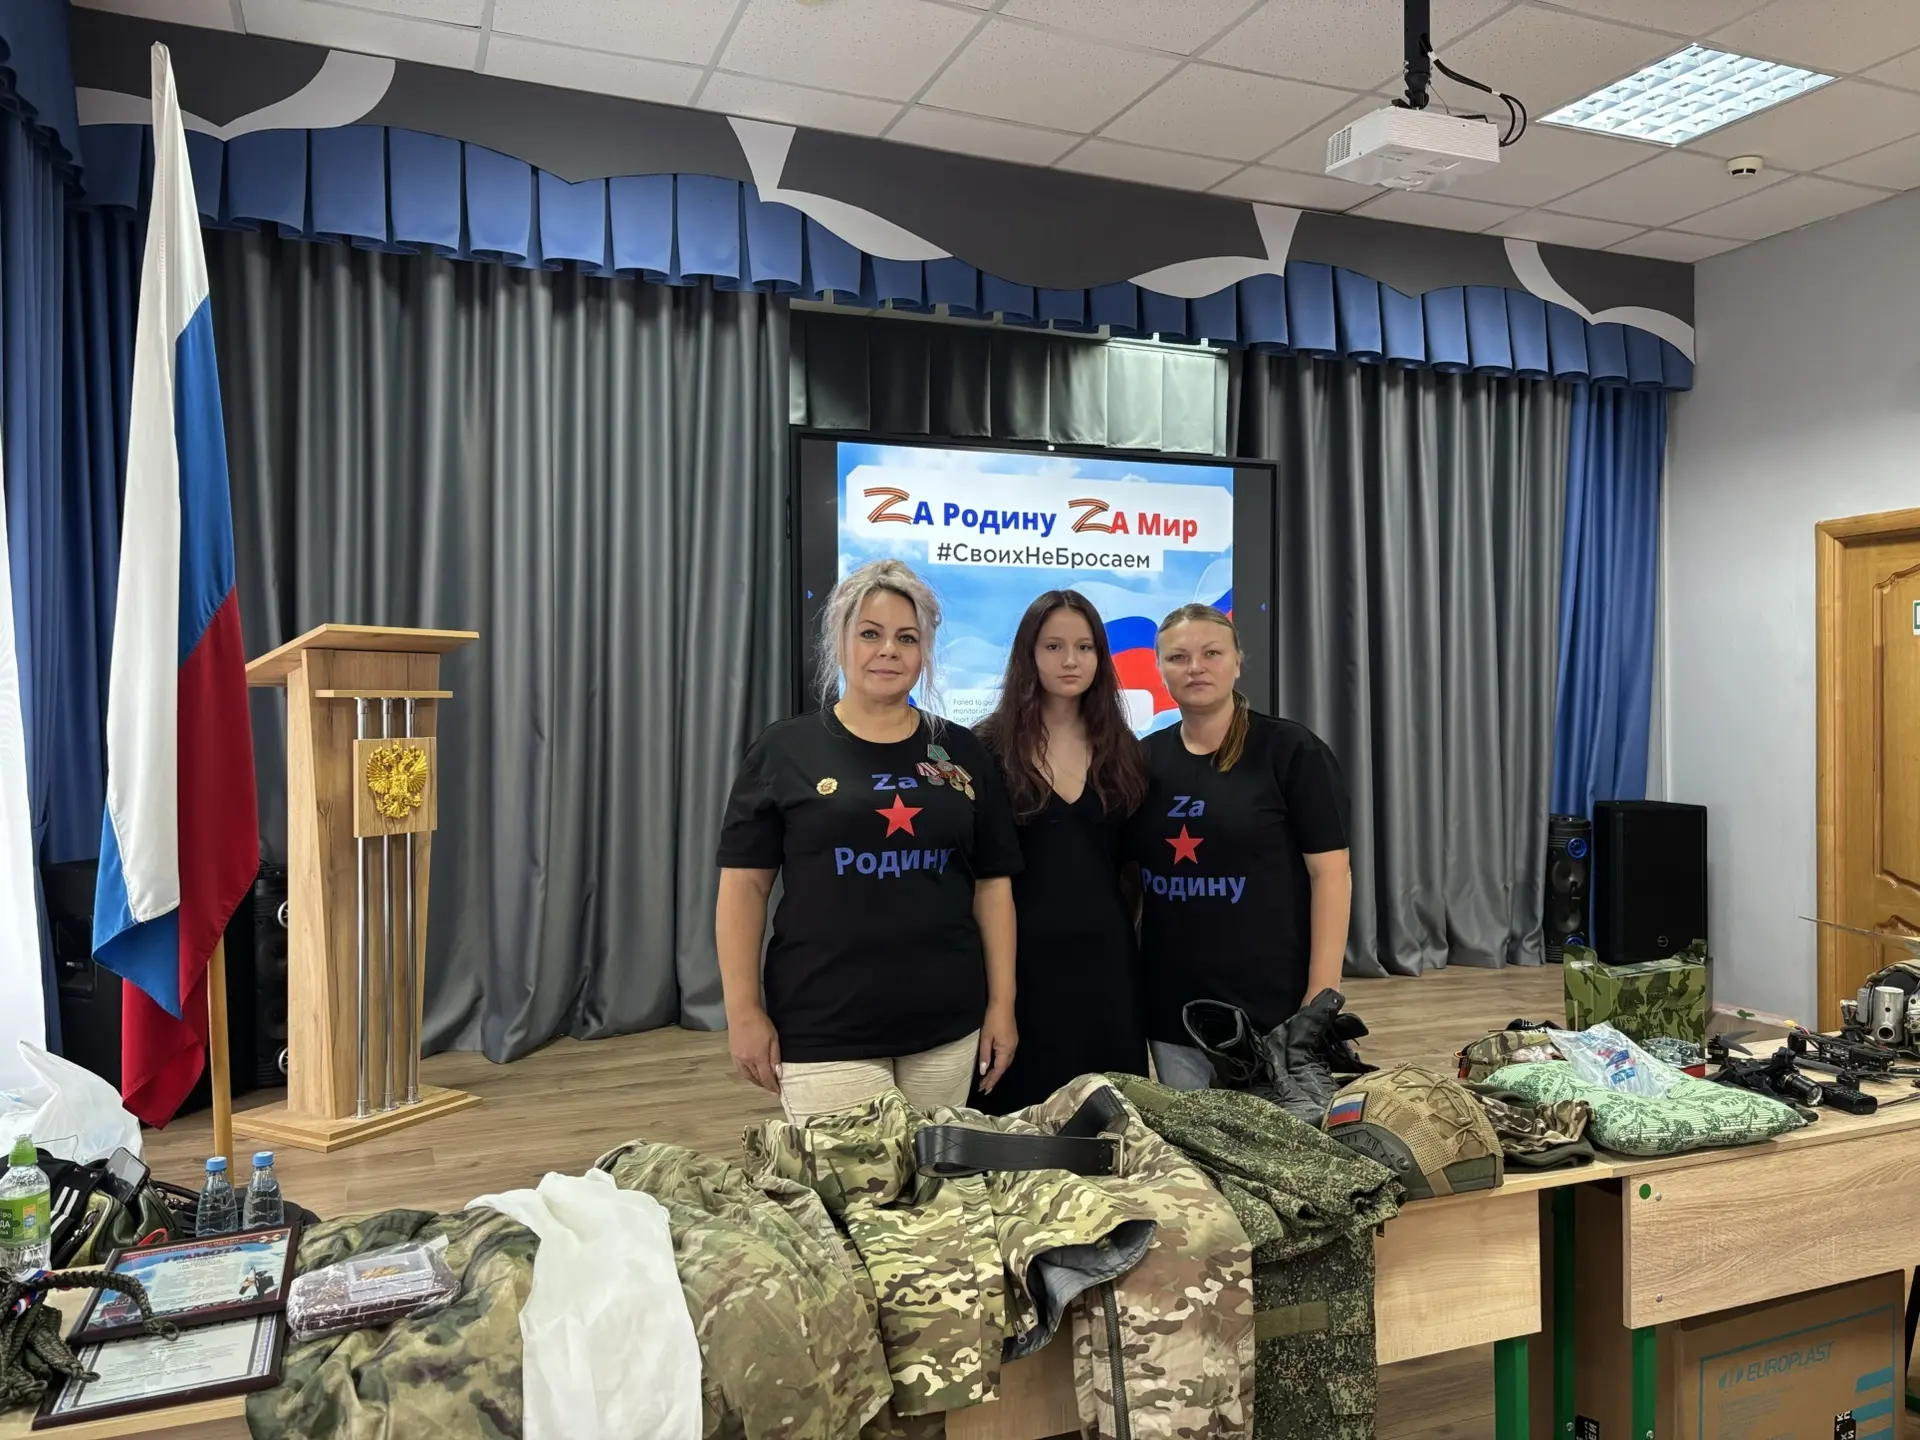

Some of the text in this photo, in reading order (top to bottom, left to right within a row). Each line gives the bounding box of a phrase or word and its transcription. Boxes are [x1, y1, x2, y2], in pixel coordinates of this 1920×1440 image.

[943, 502, 1057, 538] Родину
[1138, 512, 1198, 544] Мир
[936, 542, 1150, 569] #СвоихНеБросаем
[834, 847, 956, 880] Родину
[1141, 867, 1247, 904] Родину
[1746, 1340, 1836, 1382] EUROPLAST
